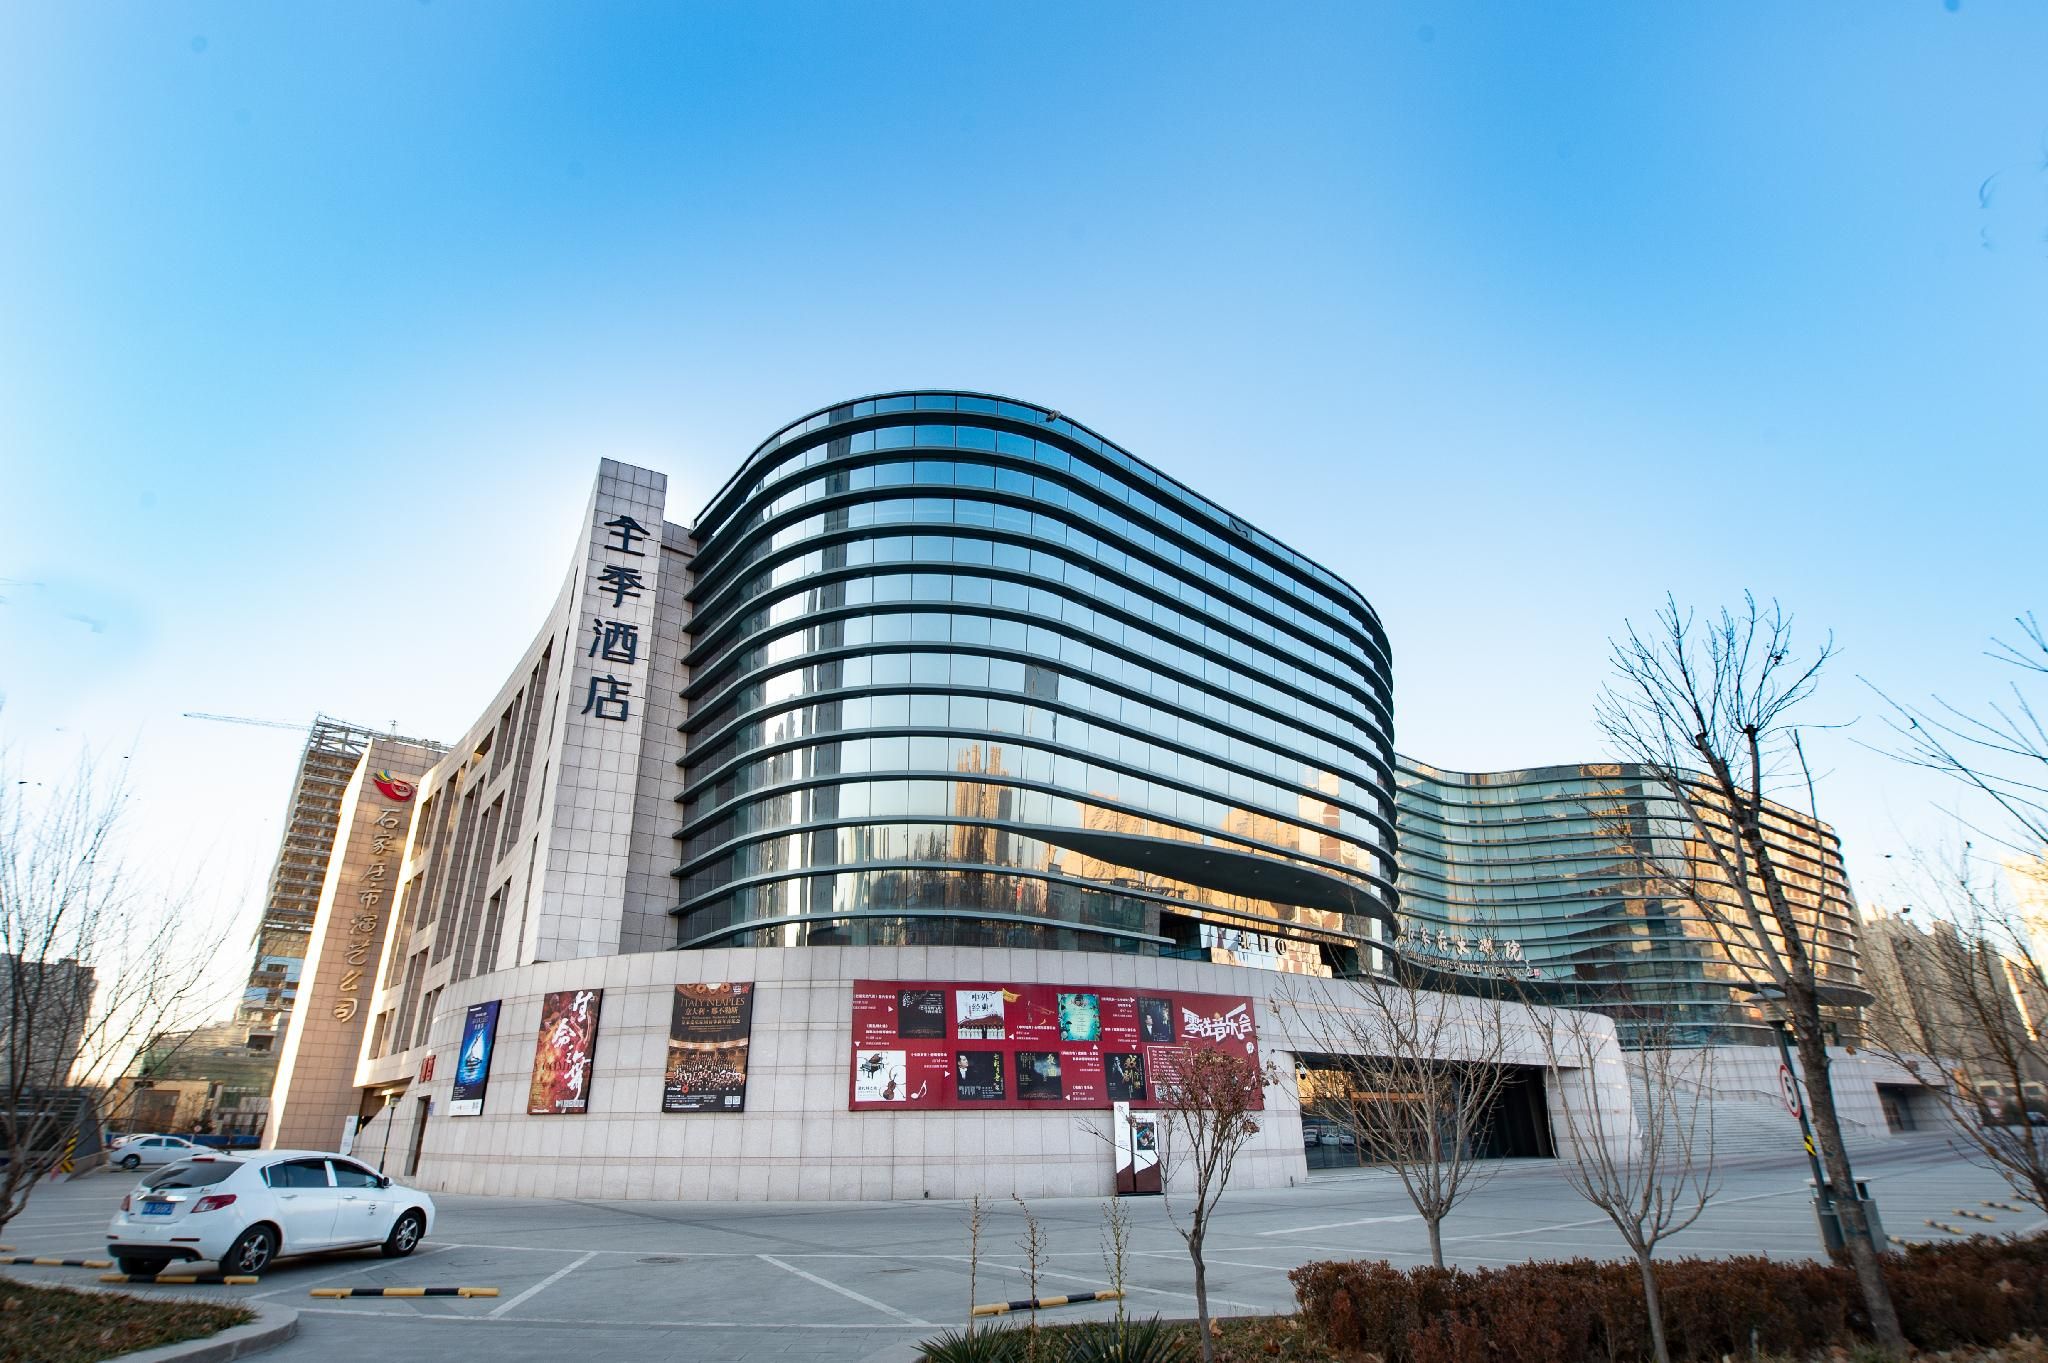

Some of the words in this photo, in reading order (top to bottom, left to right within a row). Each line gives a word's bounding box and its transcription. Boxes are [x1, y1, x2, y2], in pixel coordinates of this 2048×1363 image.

[581, 515, 650, 721] 全季酒店
[333, 808, 401, 1023] 石家庄市演艺公司
[681, 998, 705, 1007] ITALY
